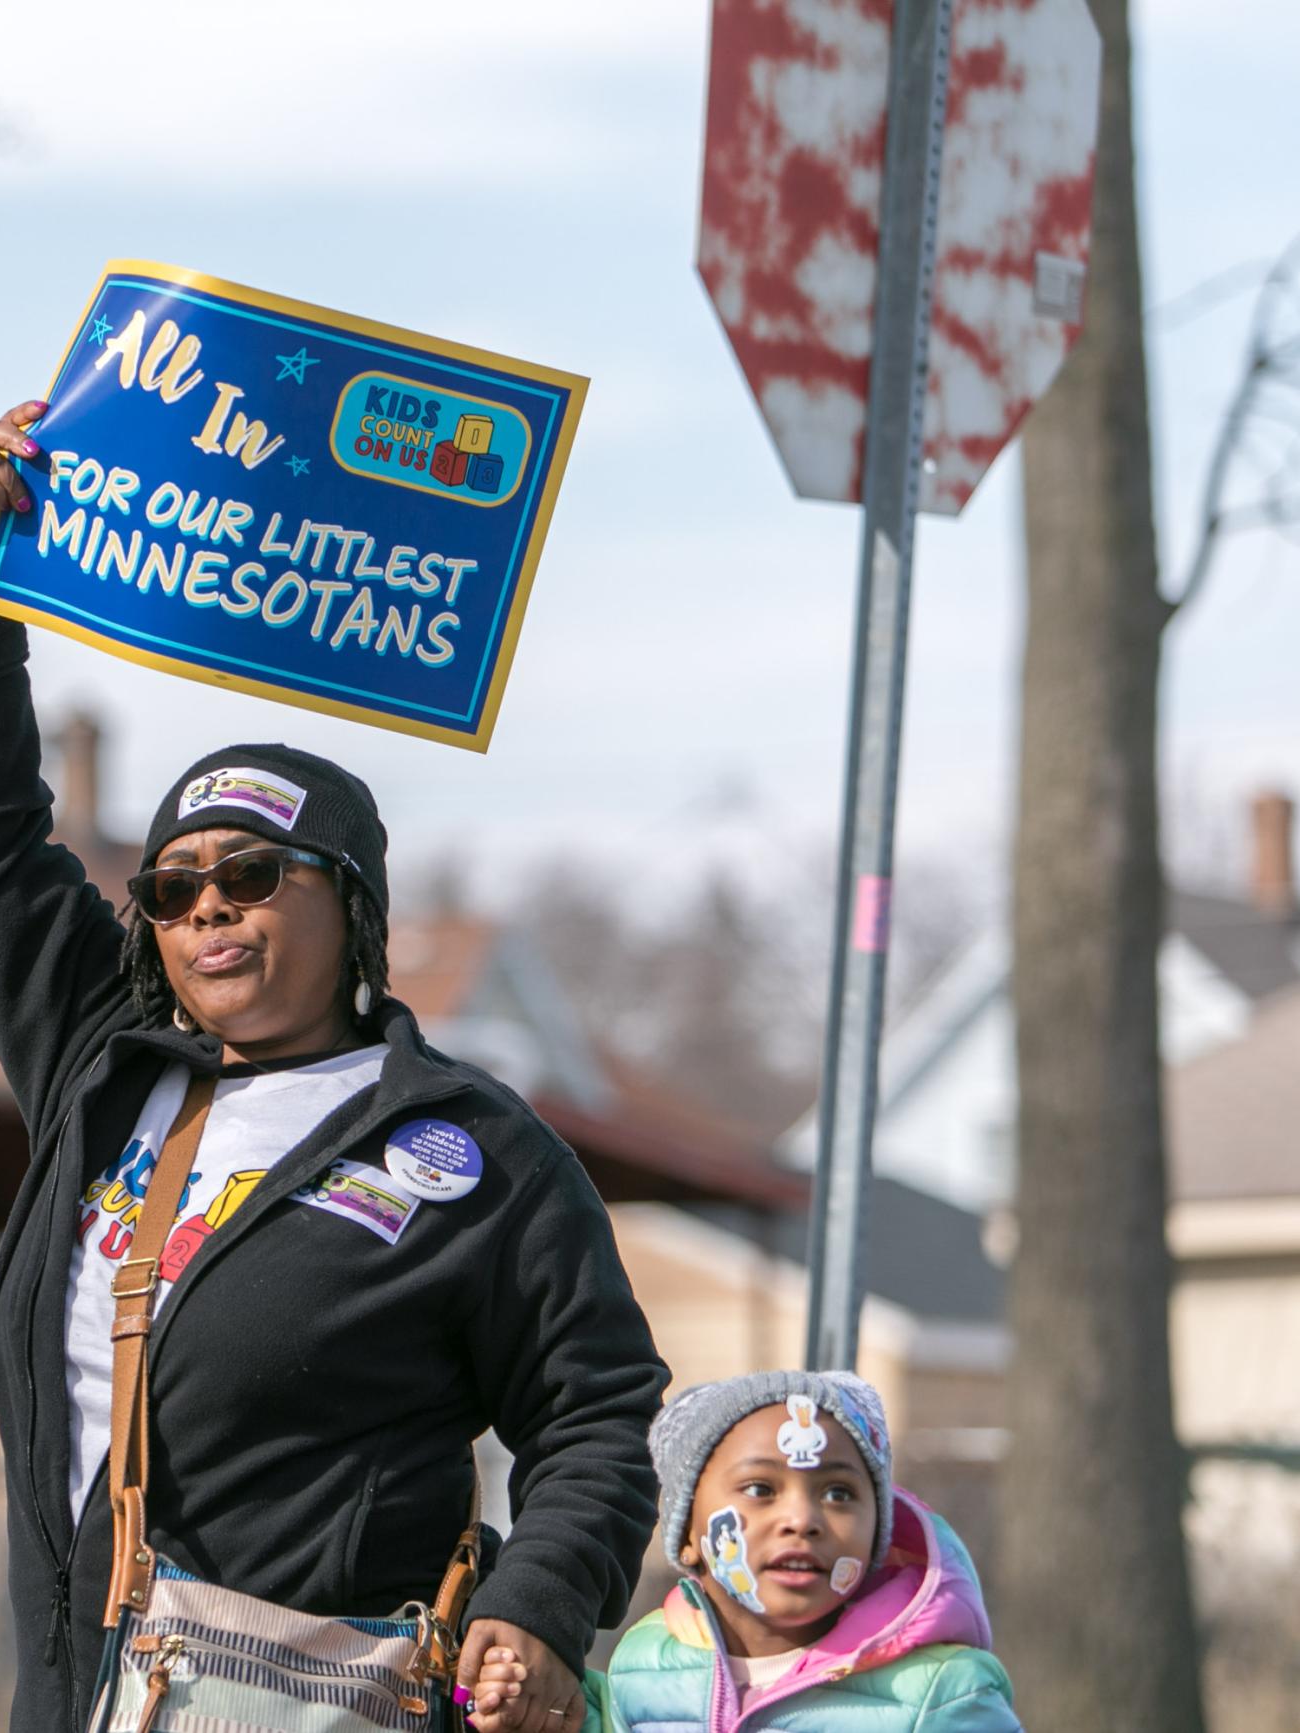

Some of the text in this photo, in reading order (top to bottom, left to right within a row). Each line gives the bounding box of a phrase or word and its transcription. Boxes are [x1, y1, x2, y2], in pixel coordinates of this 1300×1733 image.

[95, 309, 204, 404] All
[364, 384, 441, 428] KIDS
[191, 382, 285, 470] In
[360, 415, 434, 449] COUNT
[354, 435, 429, 471] ON US
[50, 450, 478, 606] FOR OUR LITTLEST
[38, 500, 460, 667] MINNESOTANS
[420, 1132, 465, 1153] childcare
[422, 1140, 452, 1157] PARENTS
[452, 1152, 468, 1163] CAN
[432, 1127, 455, 1141] work
[456, 1136, 466, 1145] in
[411, 1143, 463, 1168] WORK AND KIDS
[415, 1152, 430, 1162] CAN
[431, 1158, 454, 1171] THRIVE
[167, 1239, 190, 1269] 2
